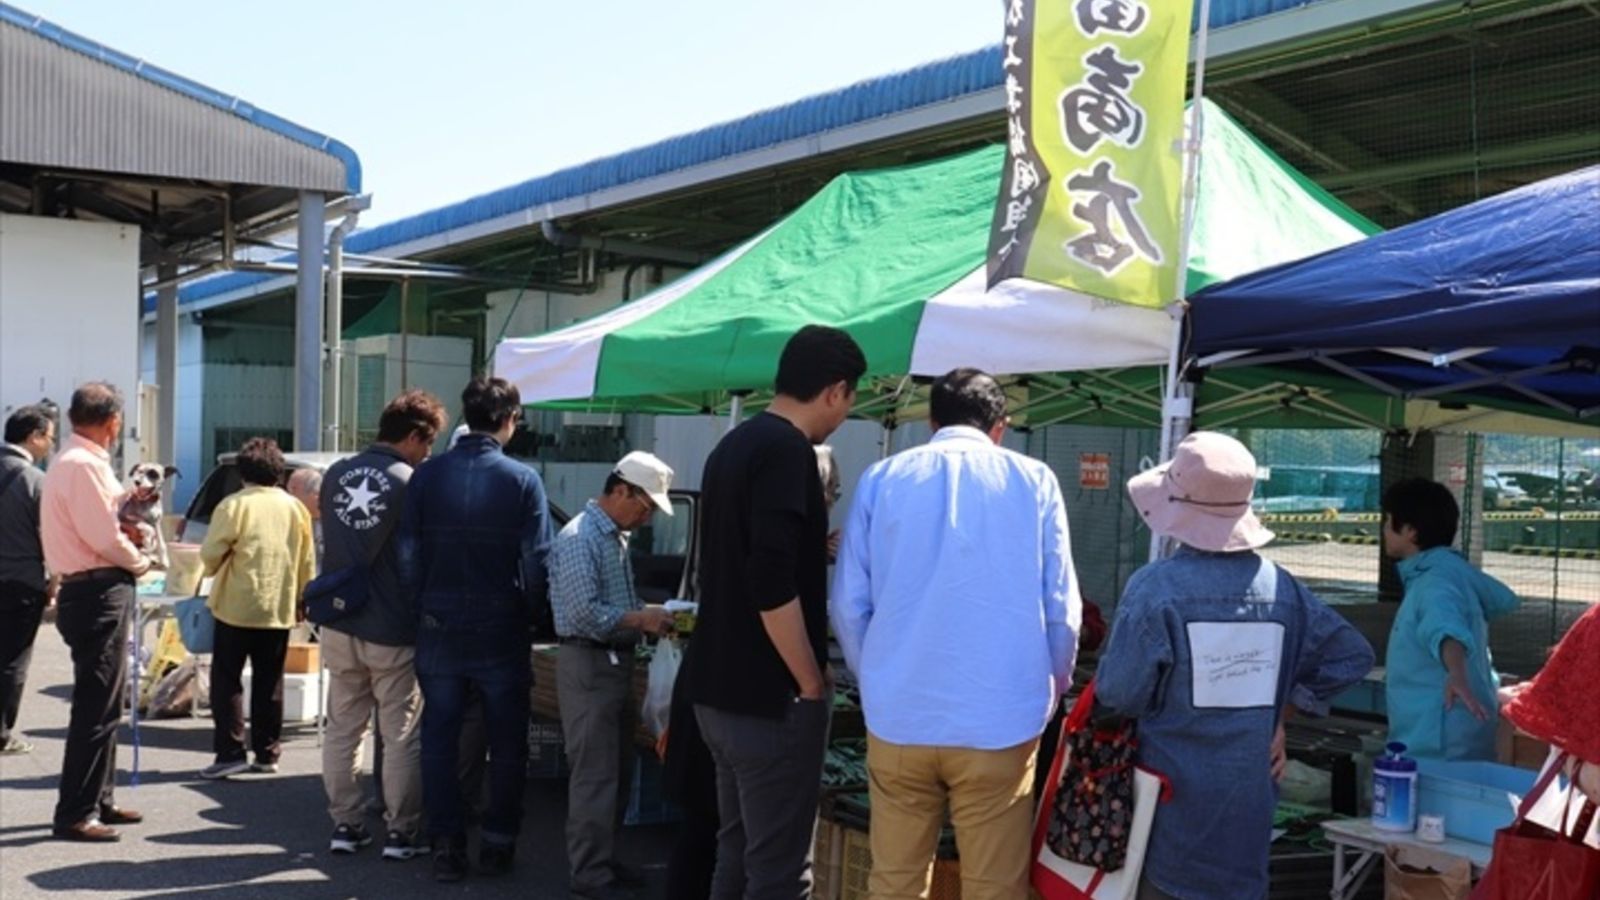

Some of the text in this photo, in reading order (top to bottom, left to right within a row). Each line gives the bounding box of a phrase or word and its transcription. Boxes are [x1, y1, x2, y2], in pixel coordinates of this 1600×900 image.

[340, 468, 391, 492] CONVERSE
[335, 508, 380, 529] ALL STAR
